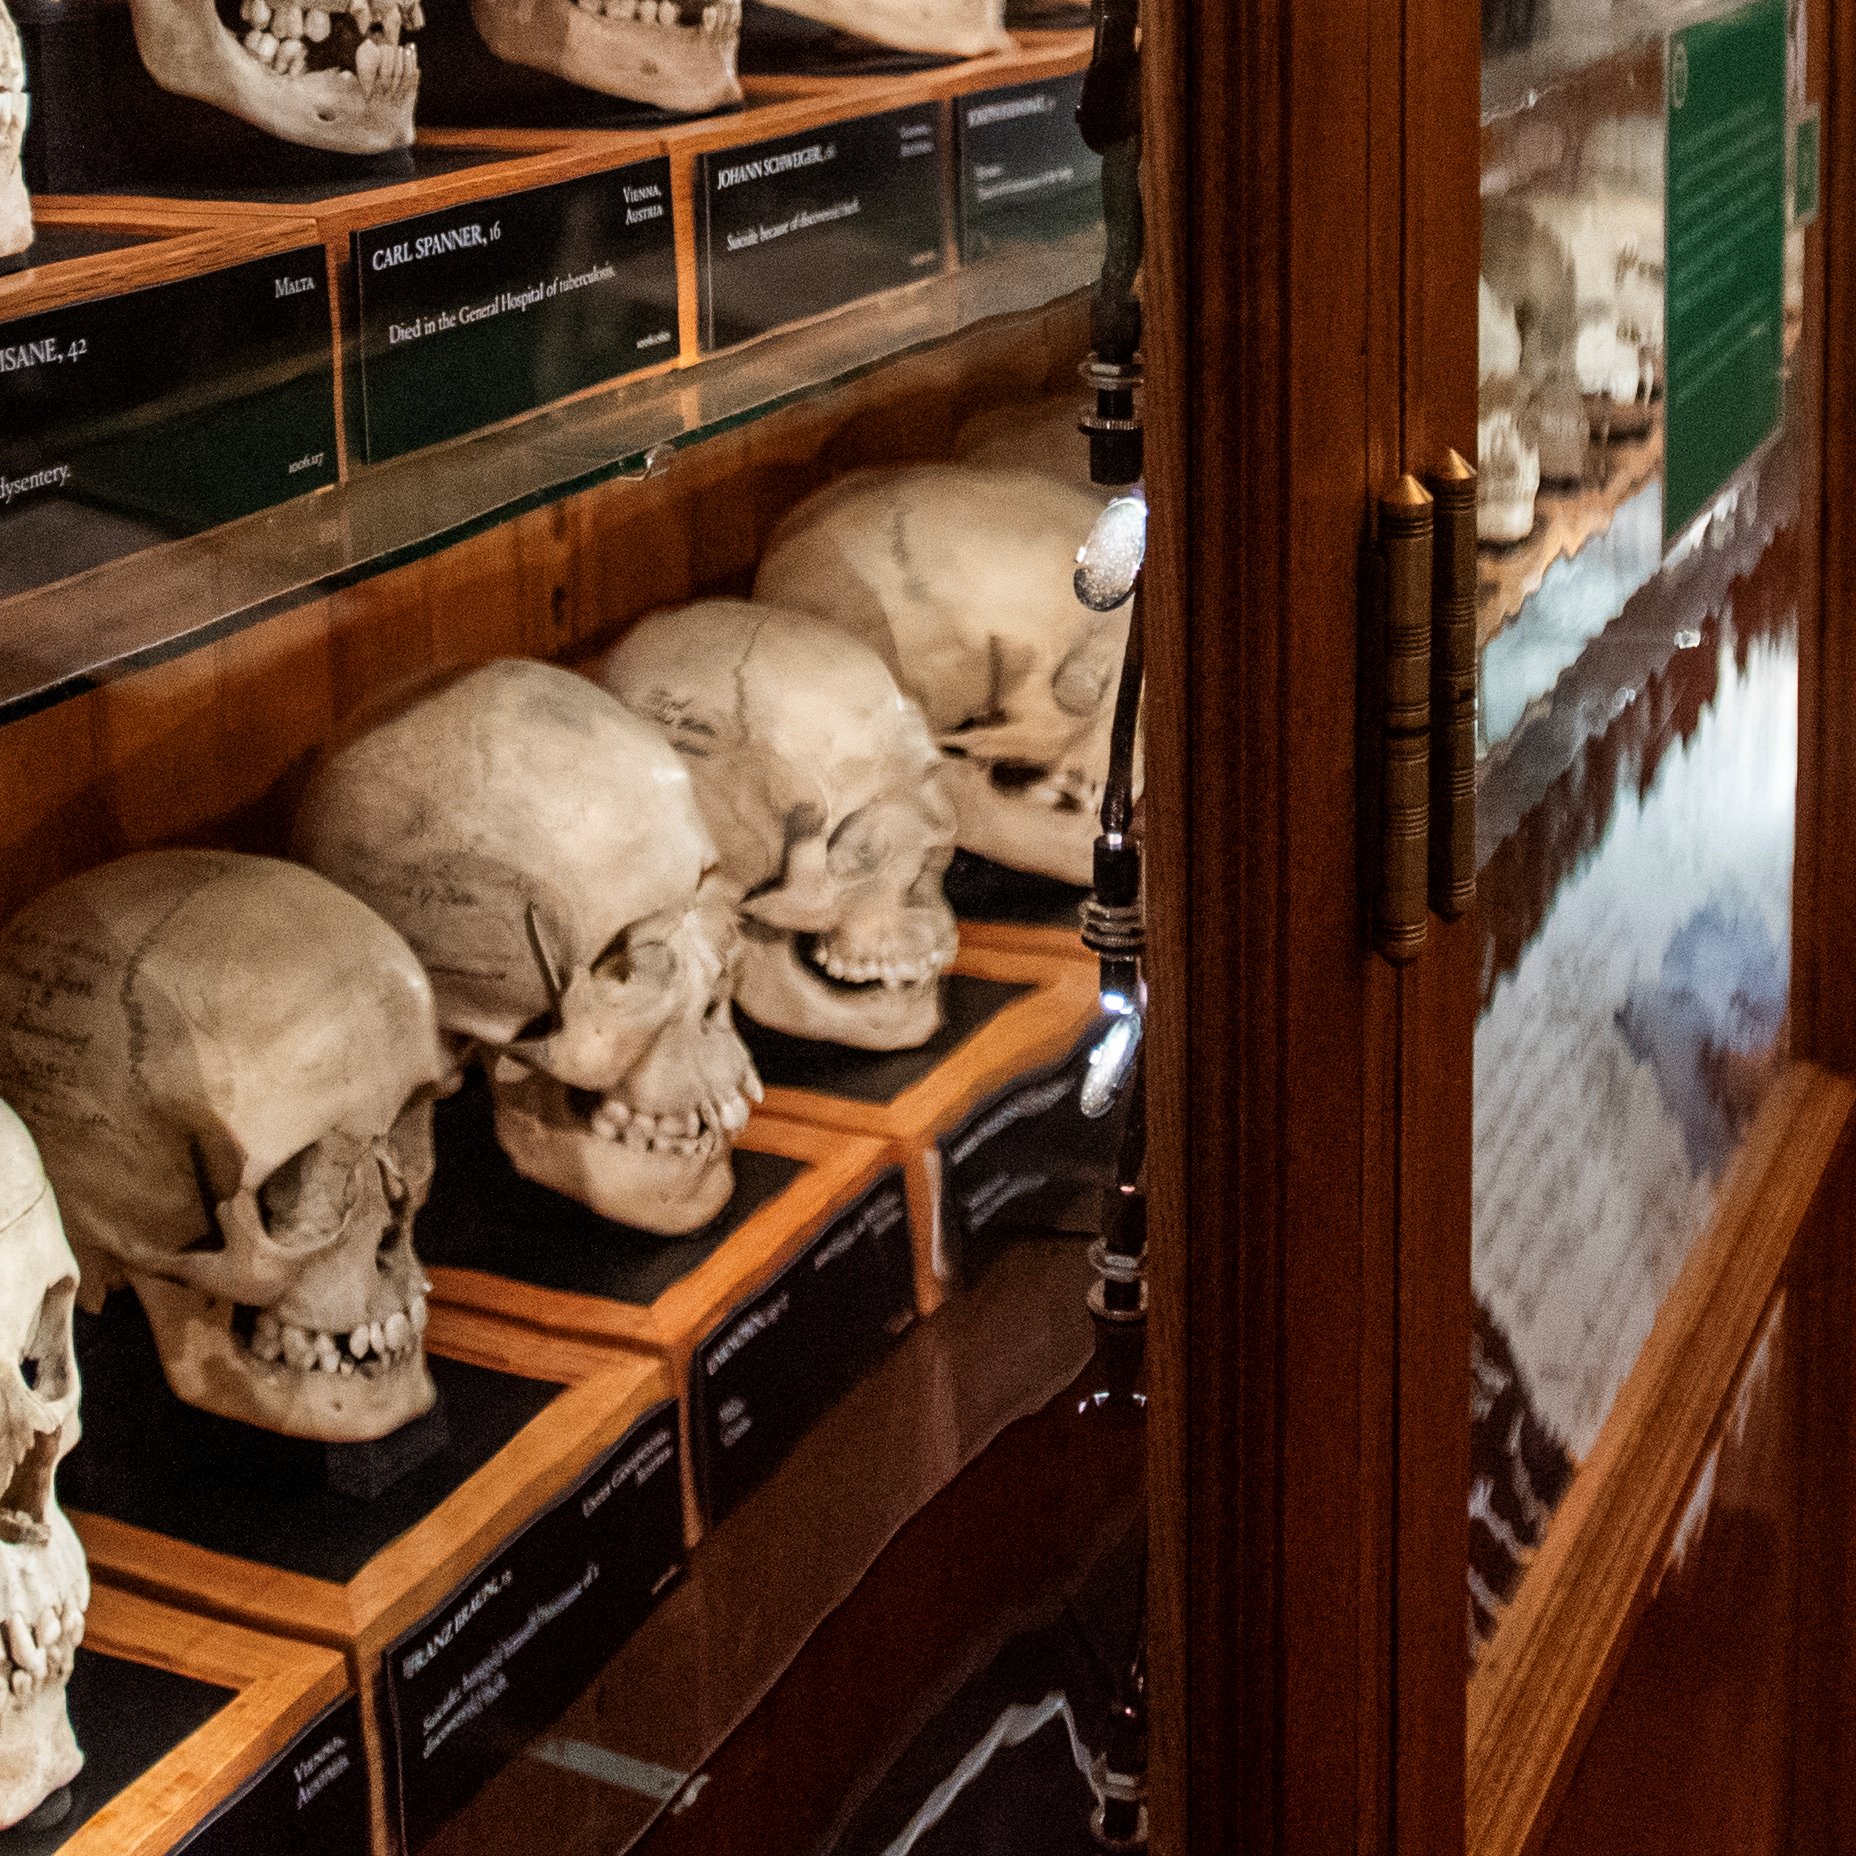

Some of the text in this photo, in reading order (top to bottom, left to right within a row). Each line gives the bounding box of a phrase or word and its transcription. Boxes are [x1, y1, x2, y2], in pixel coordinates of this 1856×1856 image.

[717, 160, 763, 190] JOHANN
[371, 241, 414, 272] CARL
[414, 223, 488, 261] SPANNER,
[274, 275, 317, 299] MALTA
[388, 317, 422, 345] Died
[423, 316, 437, 336] in
[437, 310, 457, 332] the
[457, 293, 500, 325] General
[500, 280, 546, 313] Hospital
[546, 273, 561, 299] of
[67, 337, 88, 364] 42
